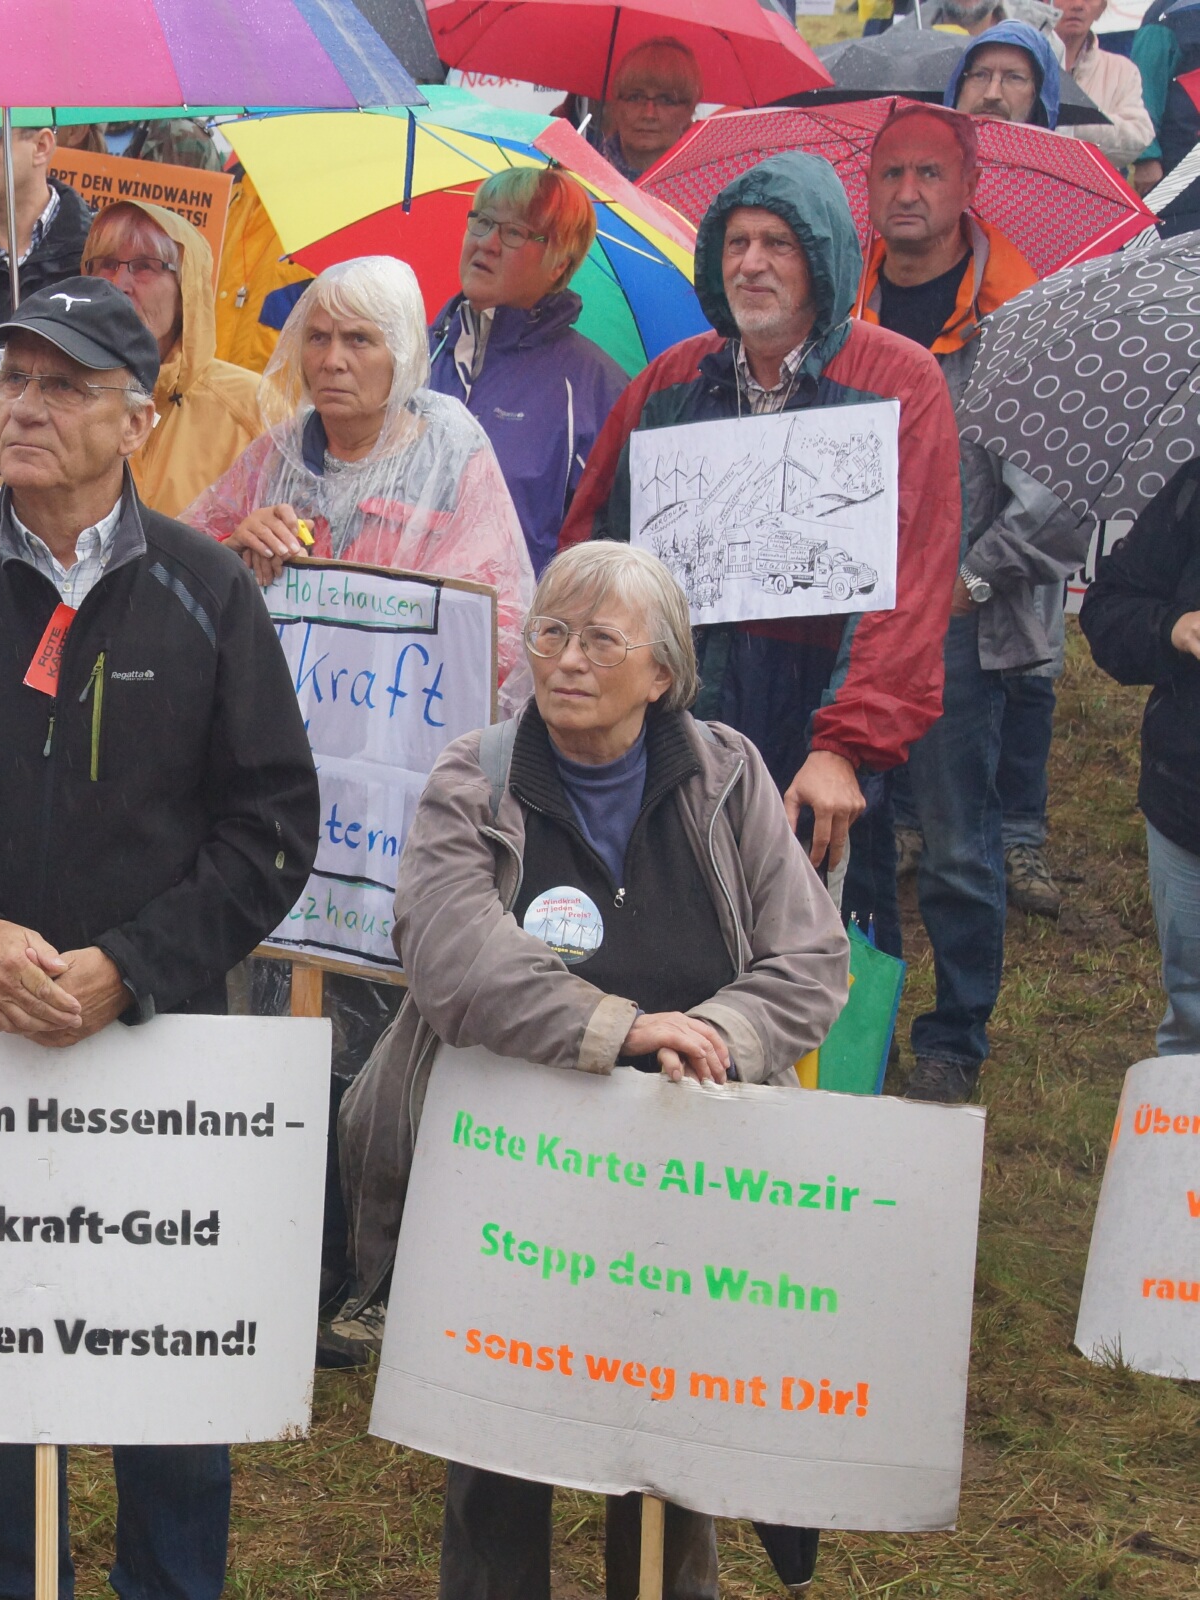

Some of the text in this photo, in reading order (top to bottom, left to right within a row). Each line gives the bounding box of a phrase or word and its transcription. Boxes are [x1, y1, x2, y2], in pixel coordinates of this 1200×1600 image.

[50, 168, 212, 209] PPT DEN WINDWAHN
[285, 568, 423, 619] Holzhausen
[37, 626, 62, 667] ROTE
[111, 671, 144, 681] Regatta
[282, 624, 446, 727] kraft
[319, 803, 401, 858] tern
[543, 898, 581, 906] Windkraft
[28, 1098, 275, 1137] Hessenland
[1134, 1103, 1200, 1135] Über
[452, 1110, 527, 1162] Rote
[535, 1133, 647, 1187] Karte
[658, 1157, 860, 1213] Al-Wazir
[480, 1221, 839, 1314] Stopp den Wahn
[1141, 1277, 1200, 1302] rau
[54, 1318, 258, 1357] Verstand!
[464, 1327, 574, 1377] sonst
[584, 1353, 676, 1401] weg
[688, 1371, 767, 1409] mit
[780, 1376, 870, 1418] Dir!
